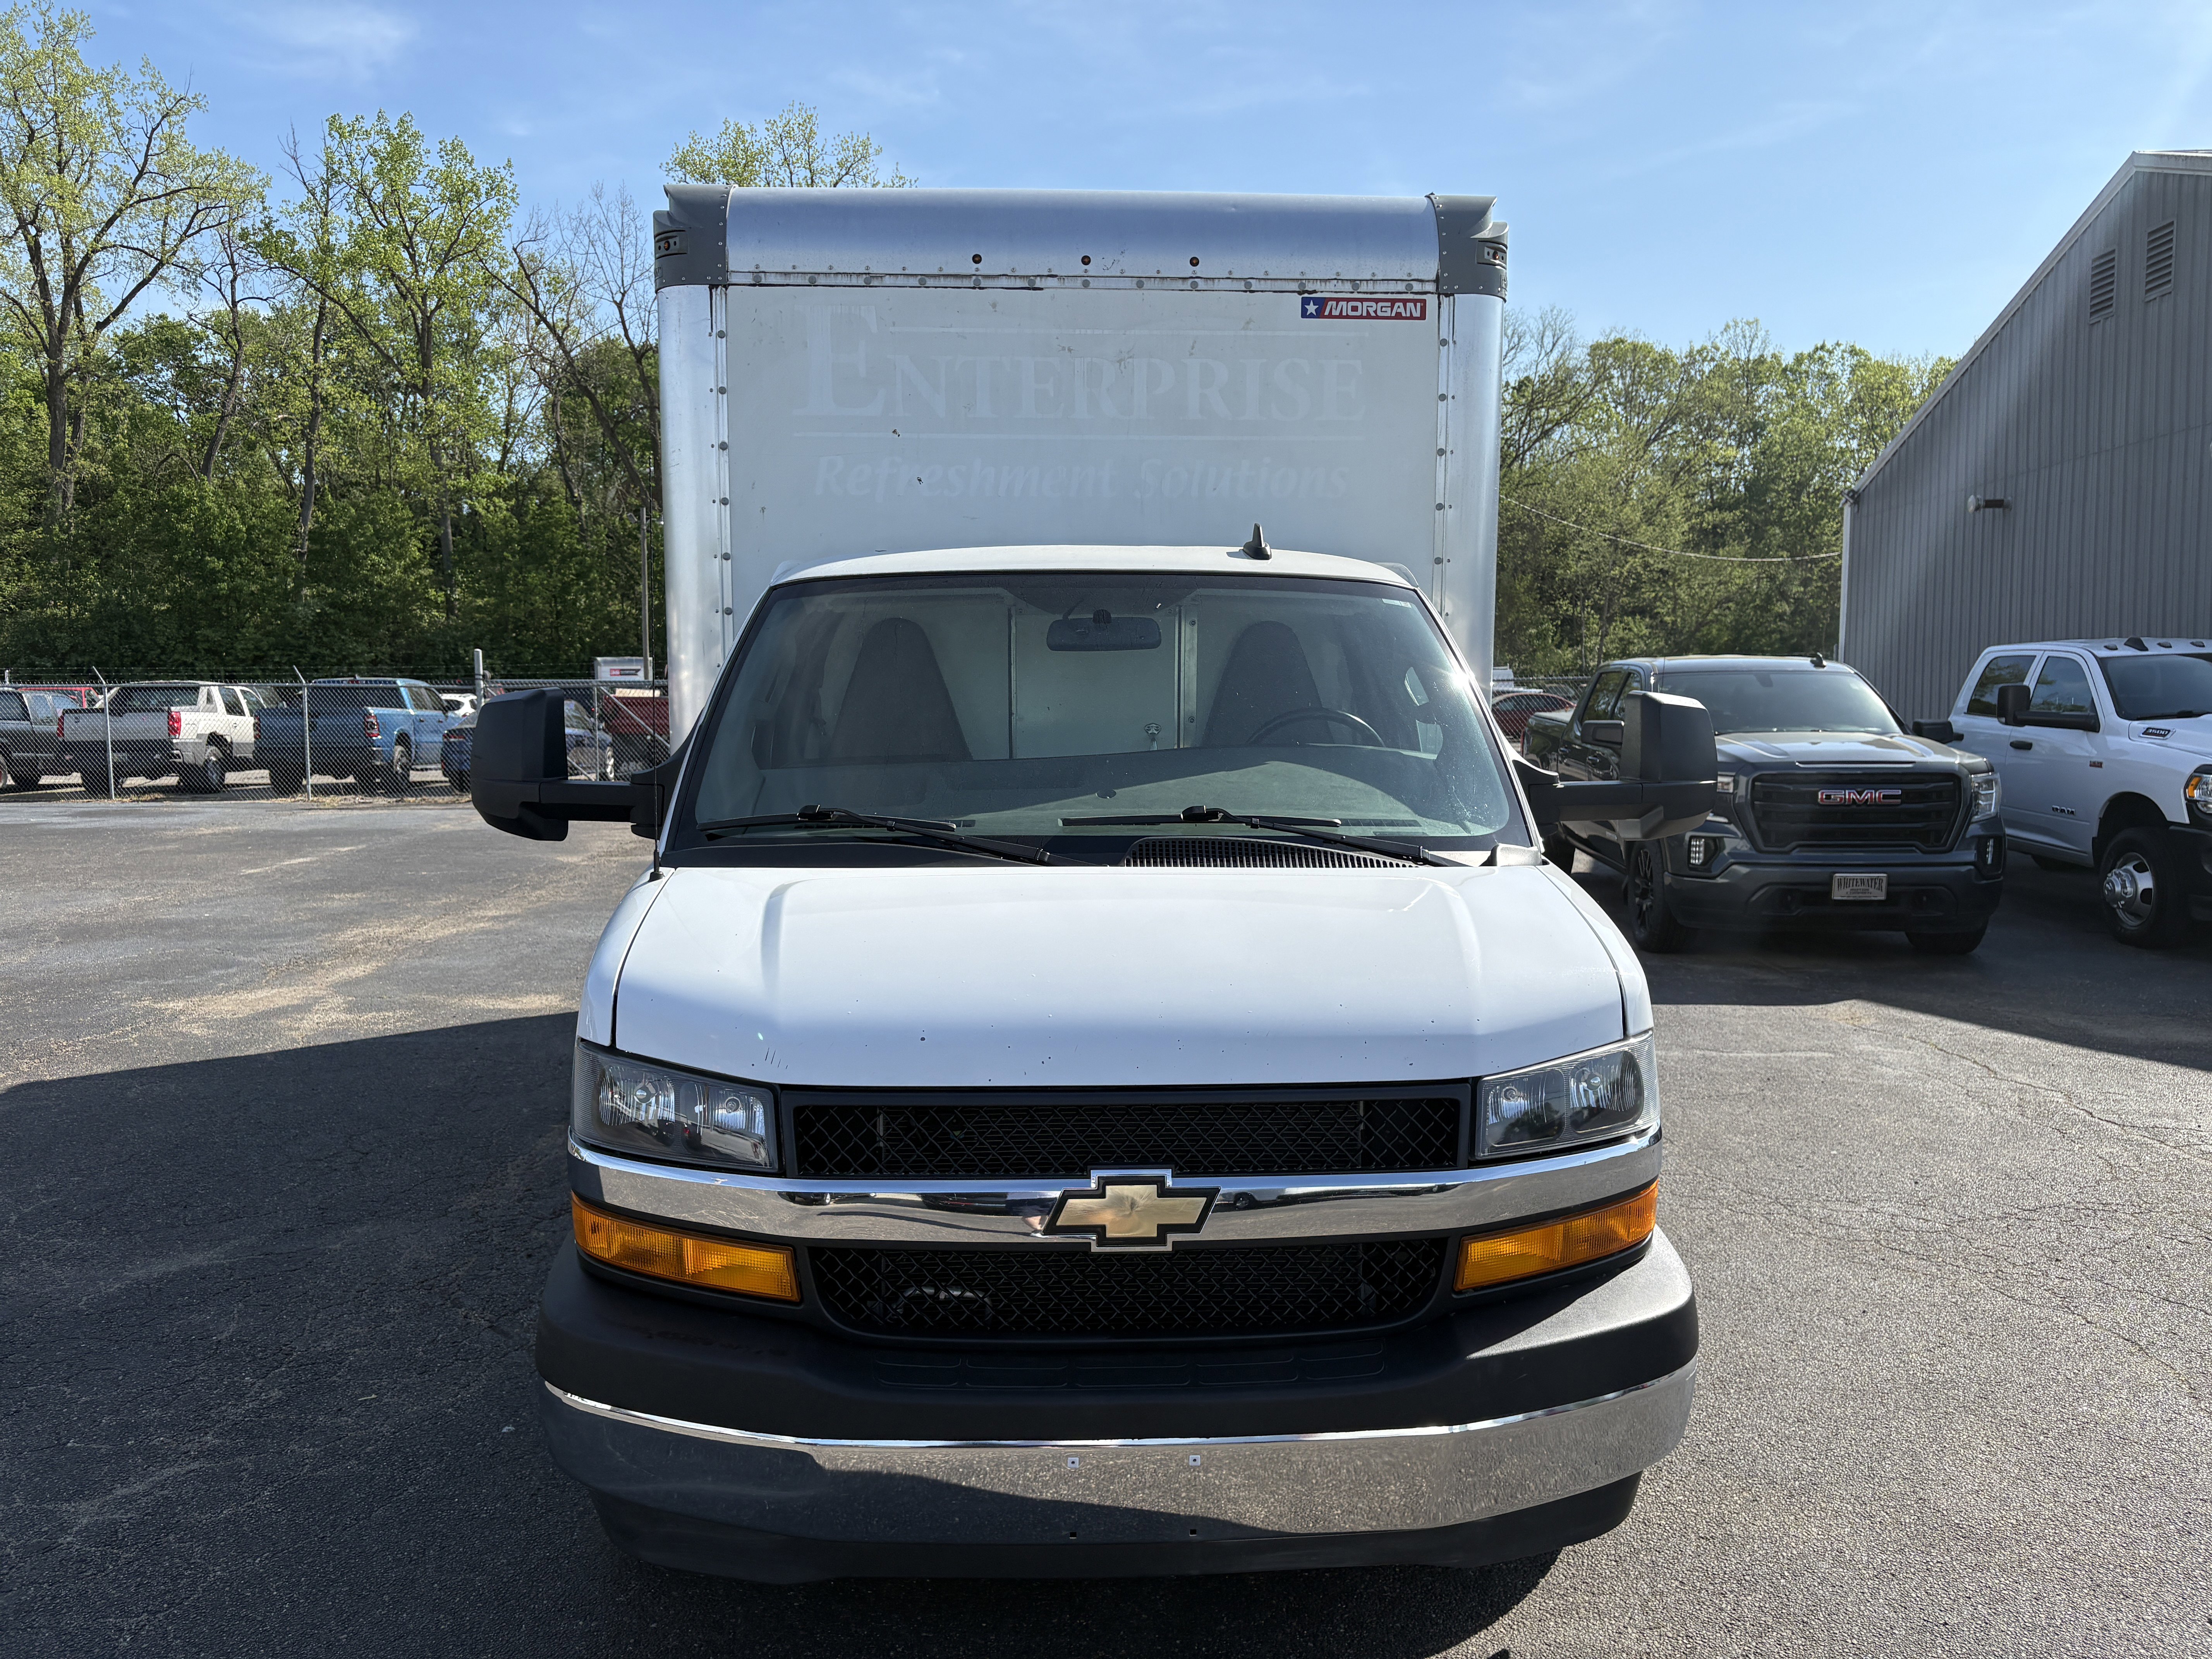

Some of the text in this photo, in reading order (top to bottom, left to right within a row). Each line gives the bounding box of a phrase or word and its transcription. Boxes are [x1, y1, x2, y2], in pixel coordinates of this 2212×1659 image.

[1324, 301, 1420, 317] MORGAN
[793, 305, 1365, 421] ENTERPRISE
[815, 455, 1348, 503] Refreshment Solutions
[1818, 790, 1901, 804] GMC
